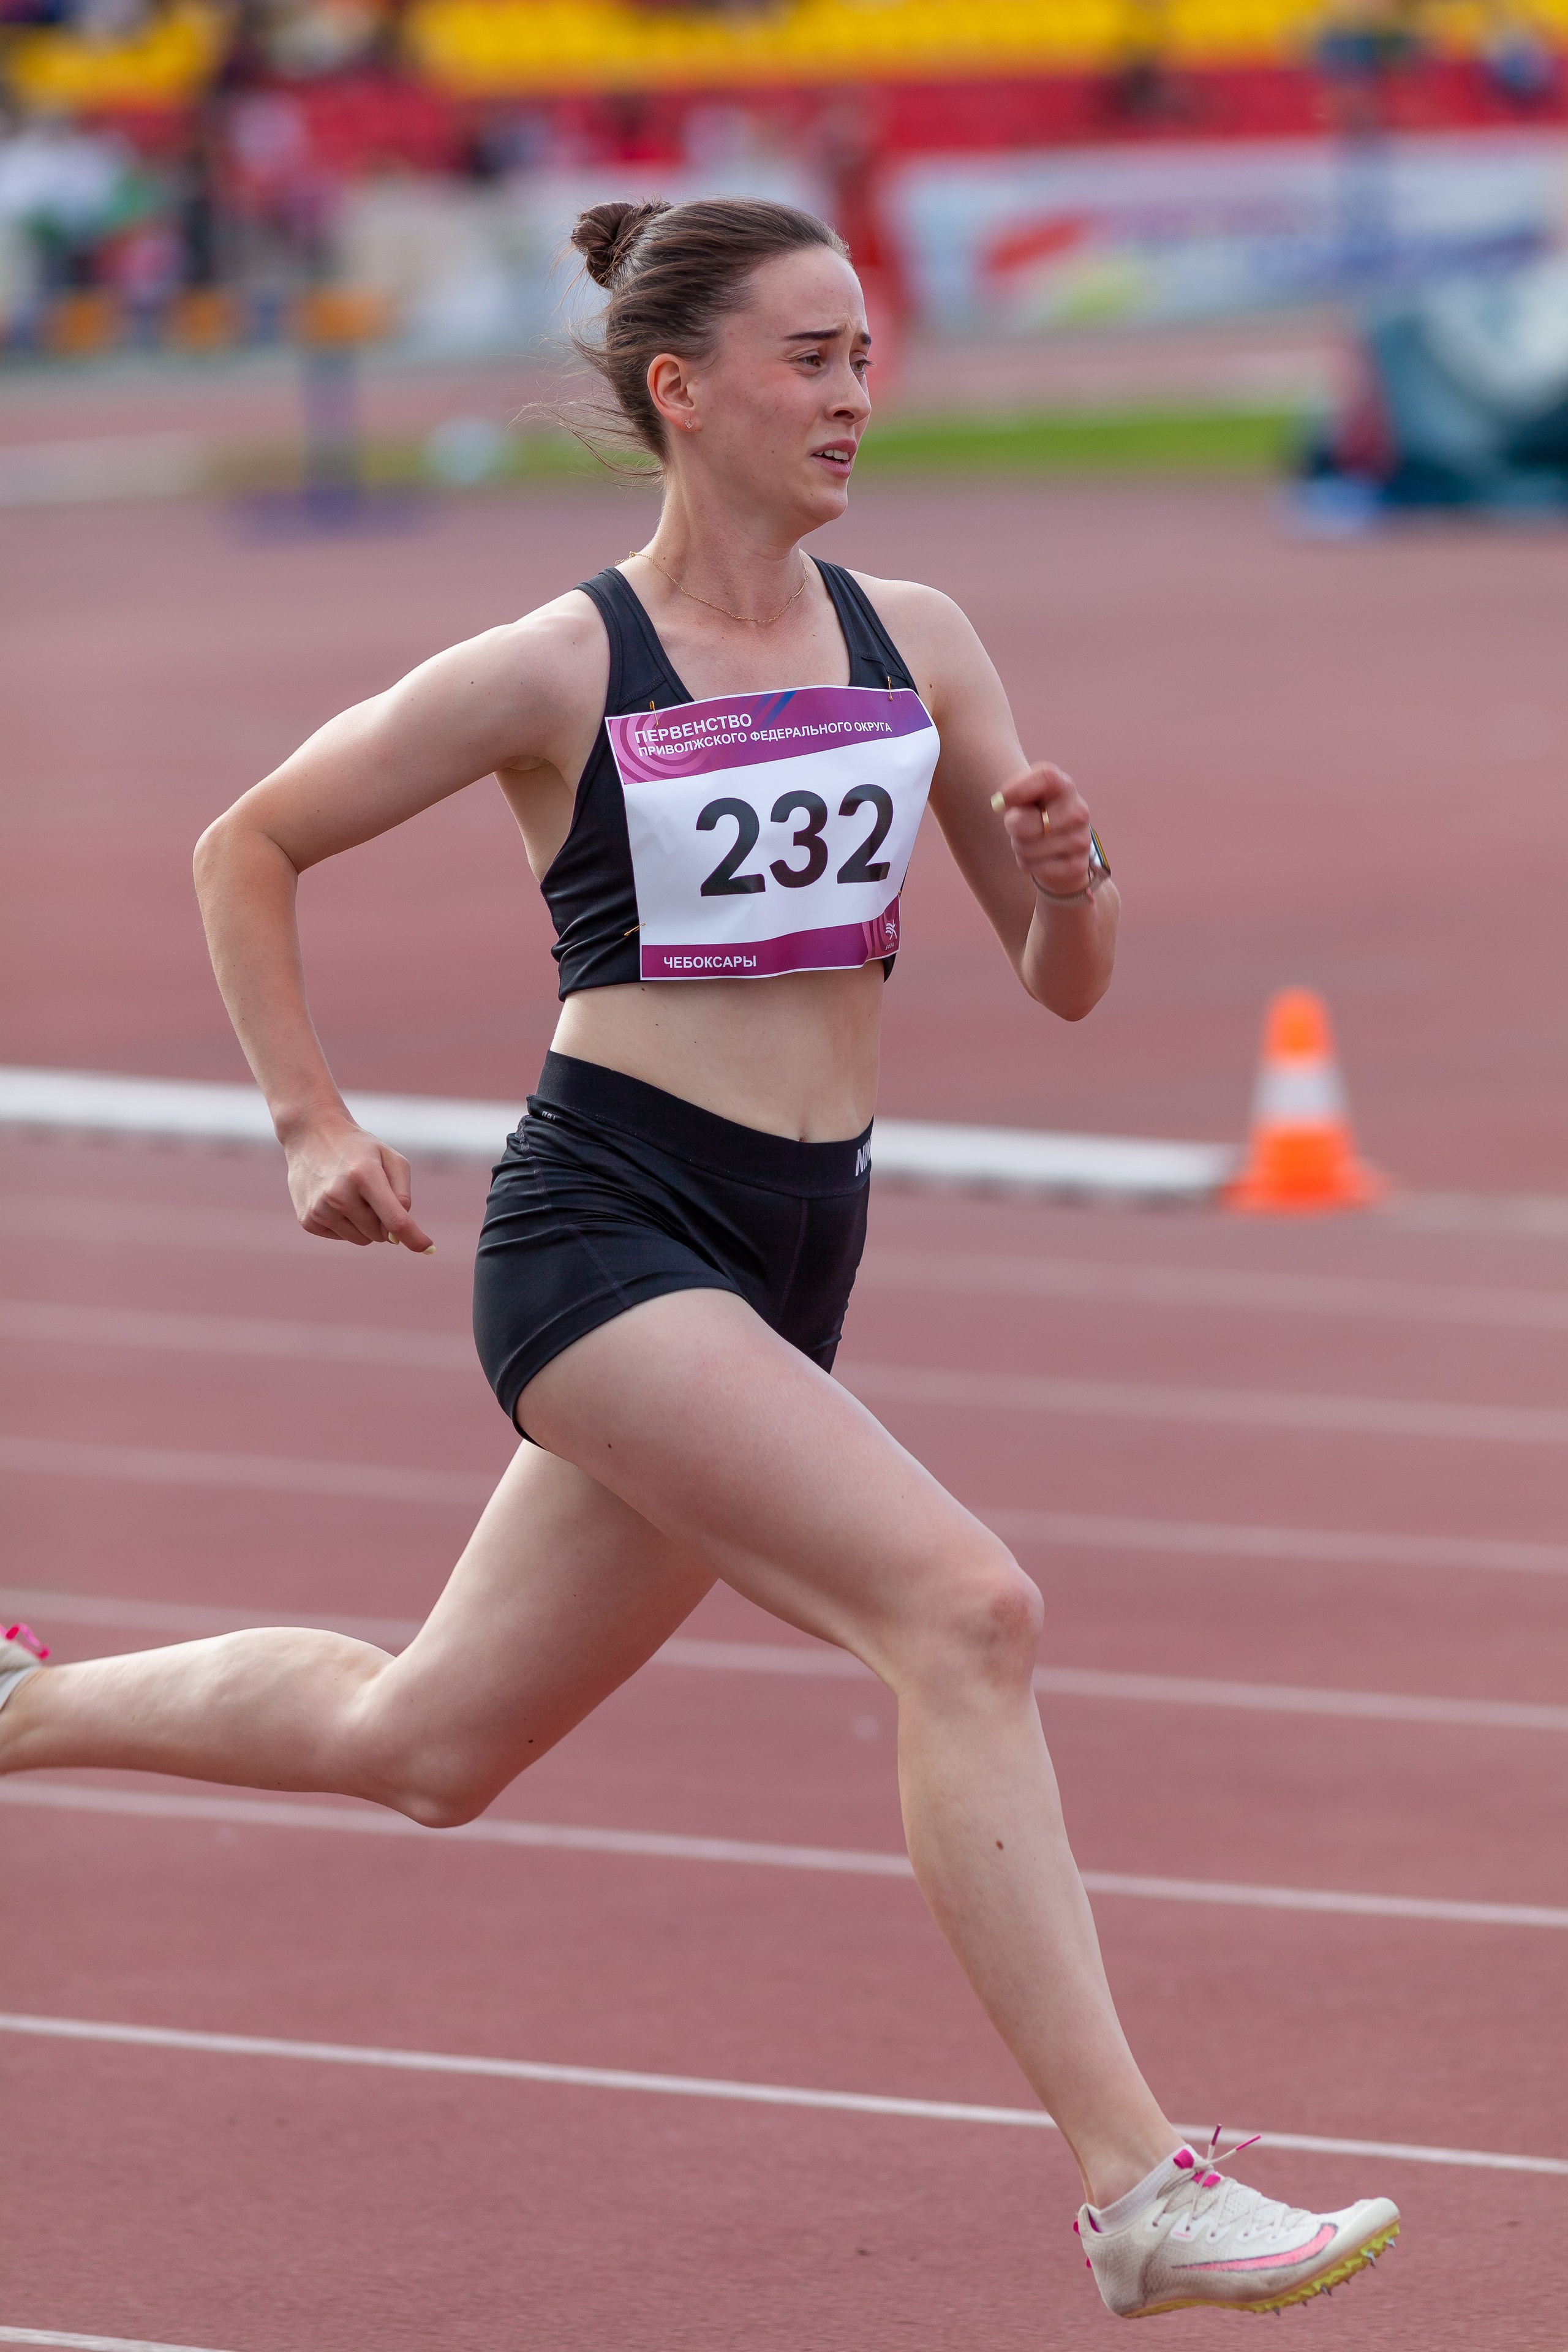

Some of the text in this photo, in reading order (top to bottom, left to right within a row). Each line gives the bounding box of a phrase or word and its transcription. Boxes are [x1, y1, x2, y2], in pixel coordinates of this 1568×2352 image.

[635, 714, 752, 743] ПЕРВЕНСТВО
[638, 722, 892, 756] ПРИВОЛЖСКОГО ФЕДЕРАЛЬНОГО ОКРУГА
[696, 784, 894, 897] 232
[663, 956, 756, 968] ЧЕБОКСАРЫ
[855, 1134, 871, 1177] NIK
